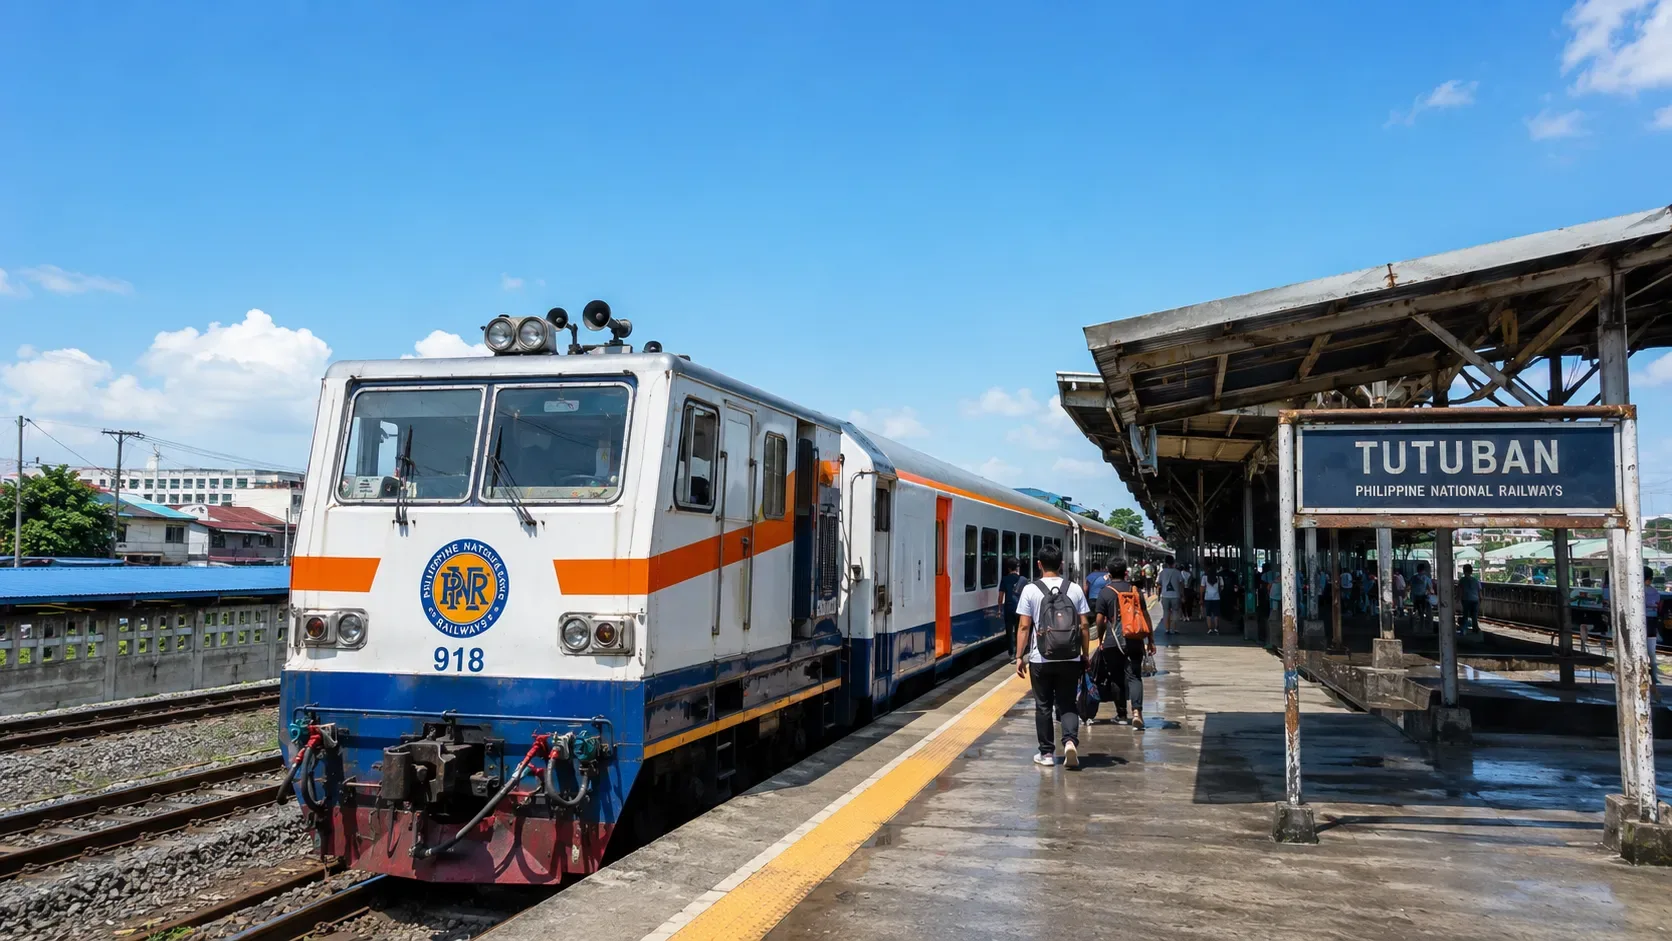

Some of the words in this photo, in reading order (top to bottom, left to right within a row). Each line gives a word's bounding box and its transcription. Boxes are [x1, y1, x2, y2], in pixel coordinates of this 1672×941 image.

[1354, 438, 1559, 475] TUTUBAN
[1355, 485, 1425, 498] PHILIPPINE
[1430, 485, 1494, 498] NATIONAL
[1498, 485, 1564, 498] RAILWAYS
[440, 566, 489, 611] PNR
[433, 646, 484, 673] 918
